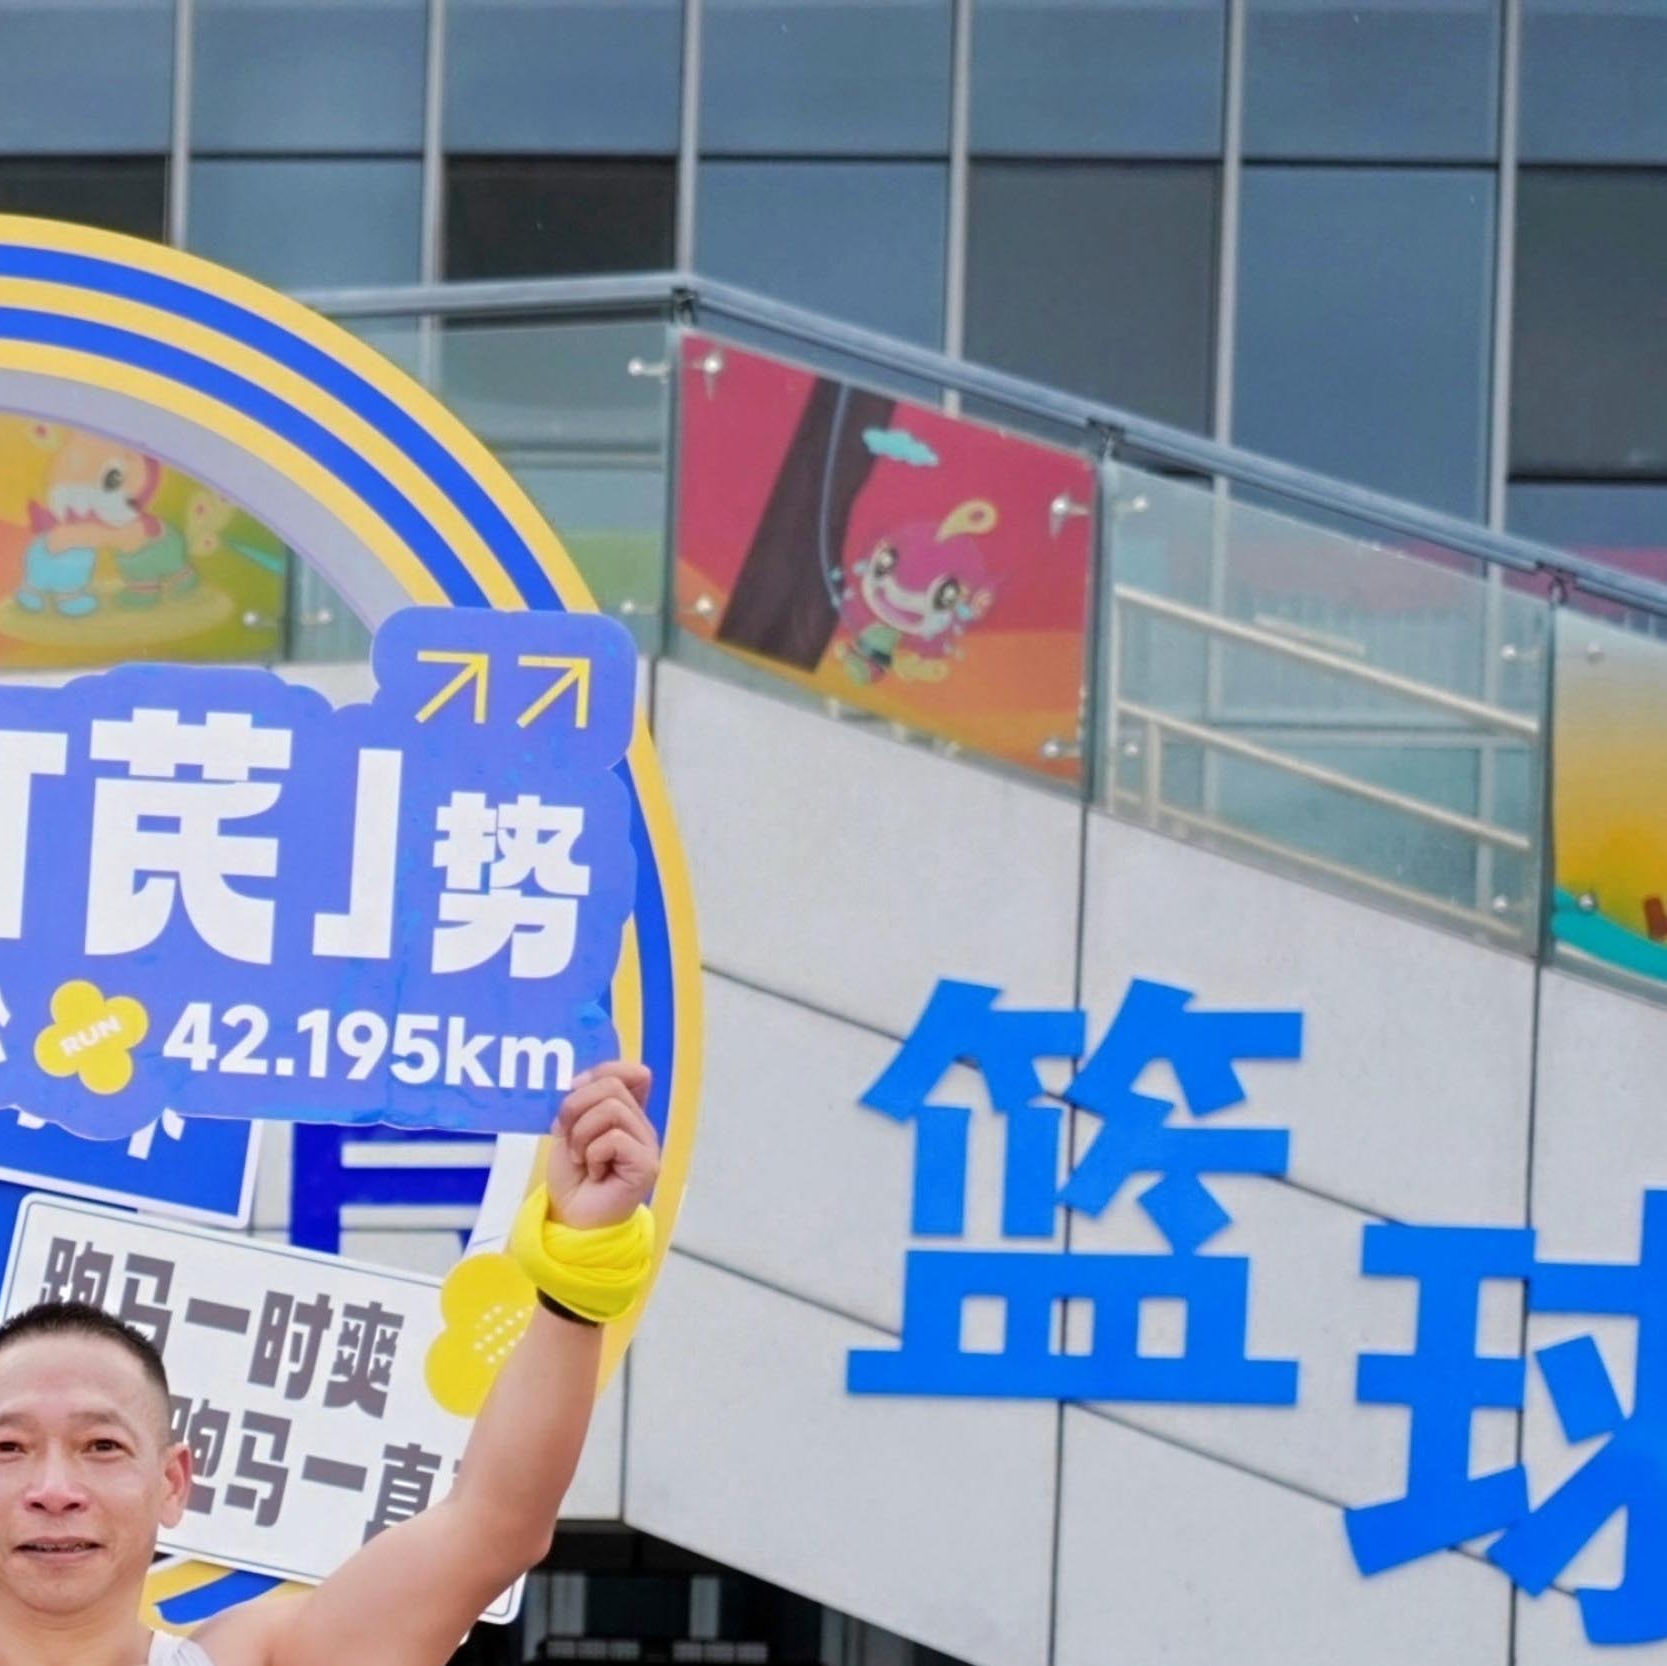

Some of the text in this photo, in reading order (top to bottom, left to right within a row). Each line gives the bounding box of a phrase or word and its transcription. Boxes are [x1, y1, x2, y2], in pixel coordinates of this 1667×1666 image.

[58, 1014, 123, 1058] RUN
[161, 1004, 575, 1092] 42.195km
[846, 977, 1667, 1646] 篮球
